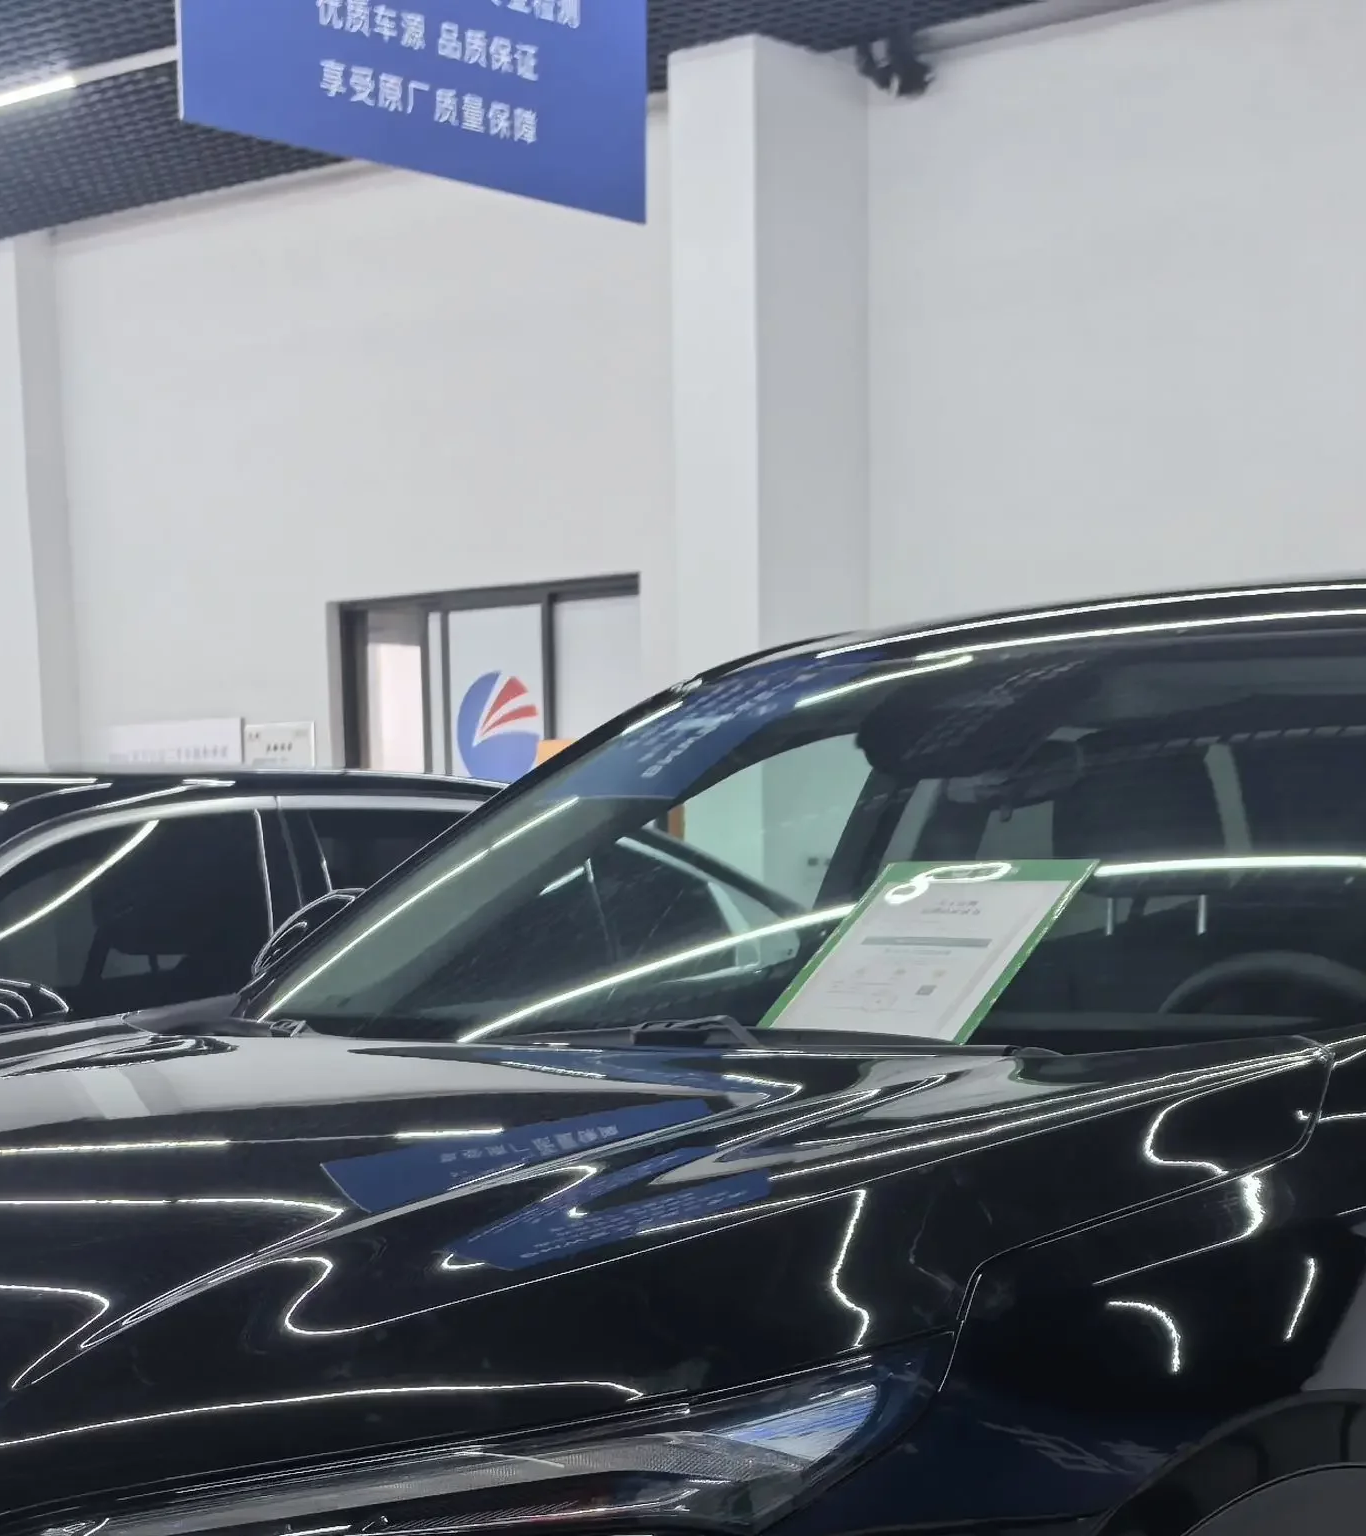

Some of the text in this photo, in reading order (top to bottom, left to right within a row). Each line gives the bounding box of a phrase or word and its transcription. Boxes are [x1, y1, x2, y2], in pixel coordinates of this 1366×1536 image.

[316, 0, 539, 81] 优质车源 品质保证
[320, 59, 537, 144] 享受原厂质量保障
